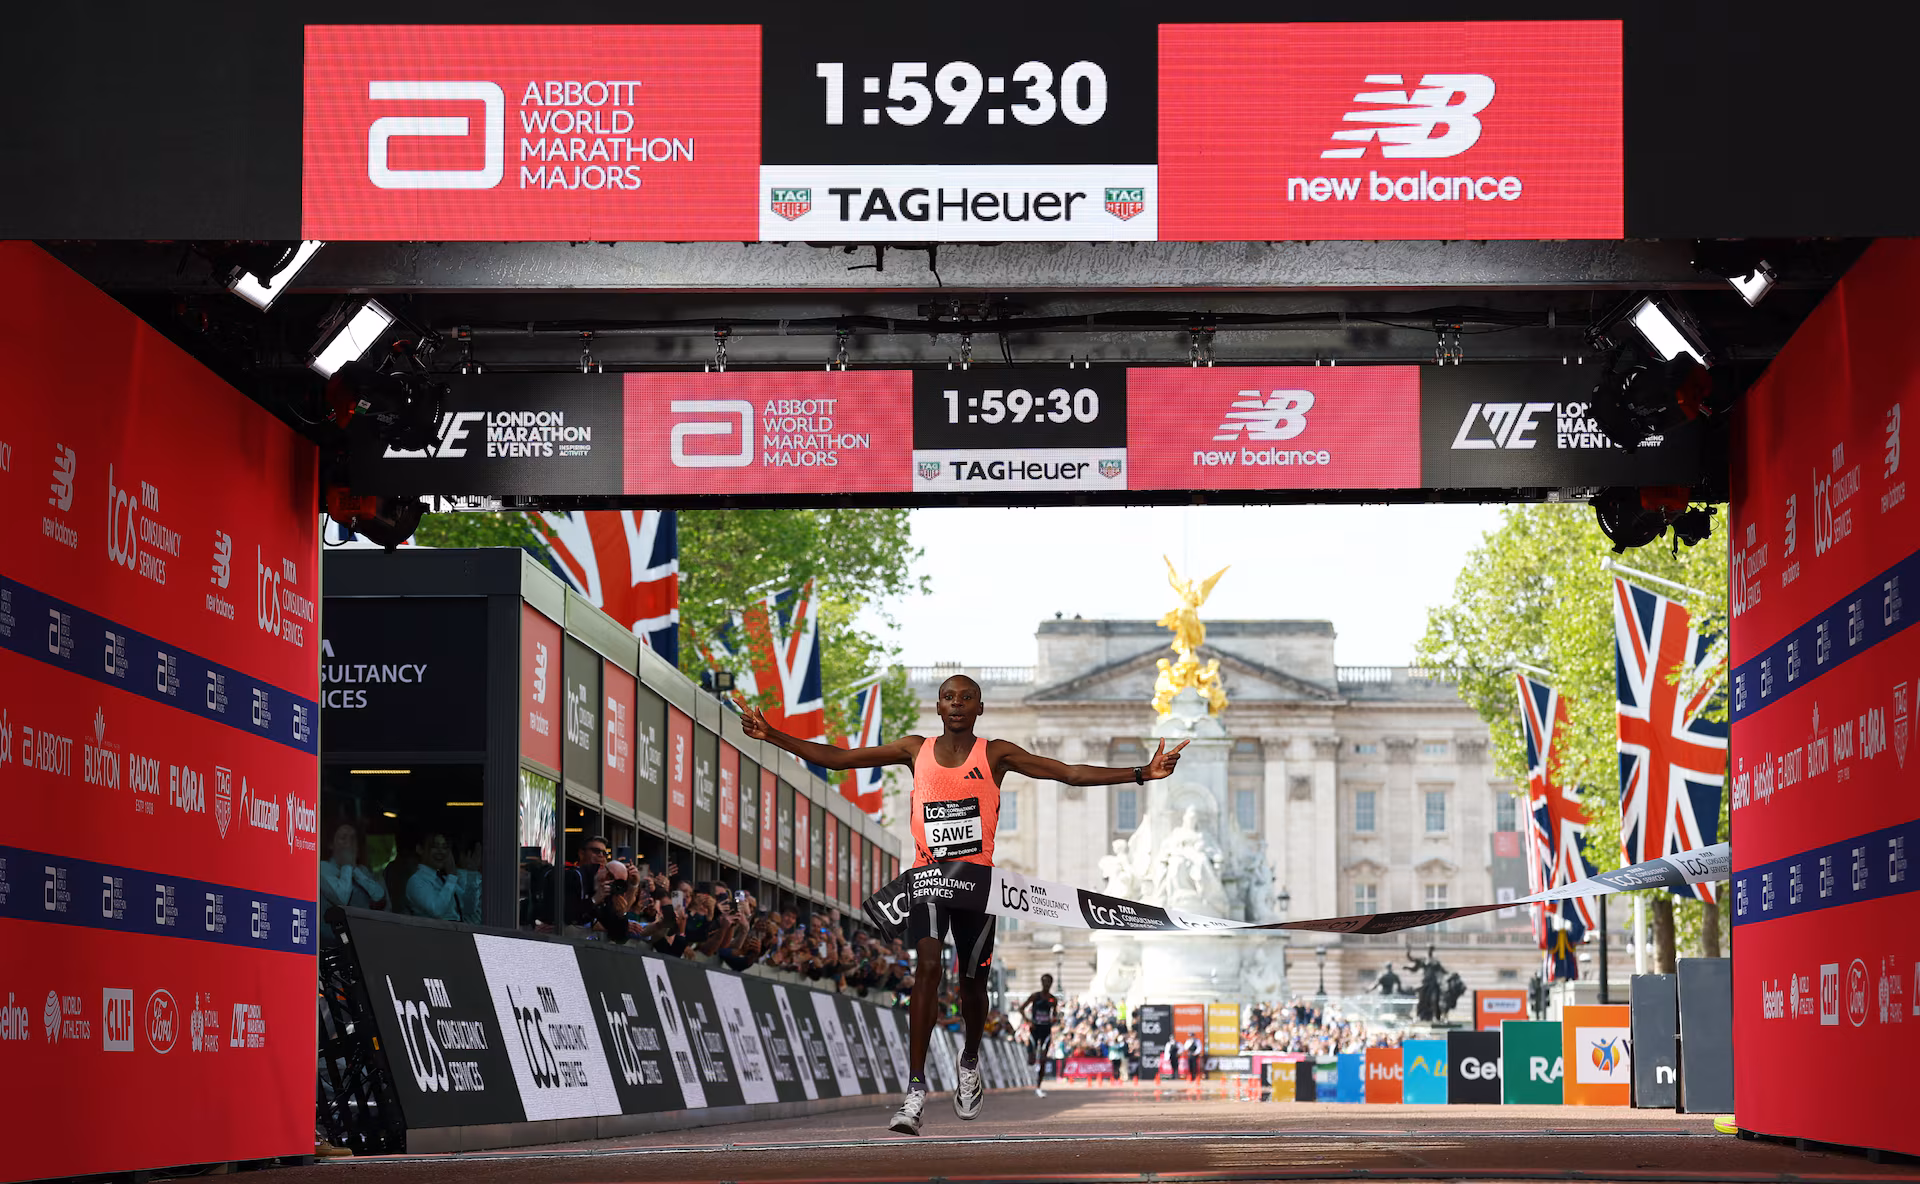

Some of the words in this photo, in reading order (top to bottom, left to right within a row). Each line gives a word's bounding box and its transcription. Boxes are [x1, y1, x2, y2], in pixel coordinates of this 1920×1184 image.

[520, 81, 642, 106] ABBOTT
[816, 61, 1108, 126] 1:59:30
[520, 110, 634, 134] WORLD
[520, 138, 695, 162] MARATHON
[520, 166, 642, 189] MAJORS
[1288, 176, 1362, 201] new
[1369, 170, 1522, 202] balance
[775, 190, 810, 201] TAG
[1108, 189, 1144, 200] TAG
[772, 202, 811, 220] HEUER
[1106, 202, 1145, 220] HEUER
[763, 399, 838, 415] ABBOTT
[943, 388, 1099, 424] 1:59:30
[487, 411, 564, 427] LONDON
[763, 417, 833, 433] WORLD
[487, 426, 591, 442] MARATHON
[763, 434, 870, 450] MARATHON
[487, 442, 553, 457] EVENTS
[763, 451, 838, 467] MAJORS
[1193, 450, 1237, 466] new
[1241, 447, 1331, 466] balance
[141, 480, 159, 512] TATA
[108, 462, 138, 570] tcs
[55, 517, 78, 549] balance
[139, 515, 181, 558] CONSULTANCY
[139, 550, 166, 585] SERVICES
[257, 544, 281, 637] tcs
[282, 588, 314, 623] CONSULTANCY
[282, 618, 304, 648] SERVICES
[1833, 720, 1854, 766] RADOX
[1859, 706, 1886, 760] FLORA
[35, 730, 73, 777] ABBOTT
[1807, 736, 1828, 779] BUXTON
[84, 743, 121, 790] BUXTON
[129, 753, 160, 795] RADOX
[170, 764, 206, 814] FLORA
[216, 771, 230, 794] TAG
[925, 805, 945, 819] tcs
[932, 825, 973, 843] SAWE
[958, 847, 977, 855] balance
[913, 868, 942, 880] TATA
[1675, 858, 1708, 876] tcs
[1710, 865, 1729, 873] SERVICES
[913, 878, 976, 891] CONSULTANCY
[1030, 885, 1047, 896] TATA
[1602, 873, 1642, 887] tcs
[913, 888, 954, 899] SERVICES
[1001, 878, 1029, 912] tcs
[1031, 896, 1070, 911] CONSULTANCY
[877, 892, 910, 925] tc
[1032, 907, 1059, 918] SERVICES
[1088, 899, 1124, 927] tcs
[1118, 904, 1137, 915] TATA
[1121, 914, 1165, 926] CONSULTANCY
[423, 977, 451, 1008] TATA
[536, 986, 560, 1013] TATA
[62, 996, 82, 1015] WORLD
[62, 1020, 91, 1039] ATHLETICS
[152, 997, 173, 1042] Ford
[385, 975, 449, 1092] tcs
[437, 1019, 488, 1050] CONSULTANCY
[506, 985, 560, 1089] tcs
[548, 1024, 590, 1050] CONSULTANCY
[449, 1061, 484, 1091] SERVICES
[558, 1061, 588, 1088] SERVICES
